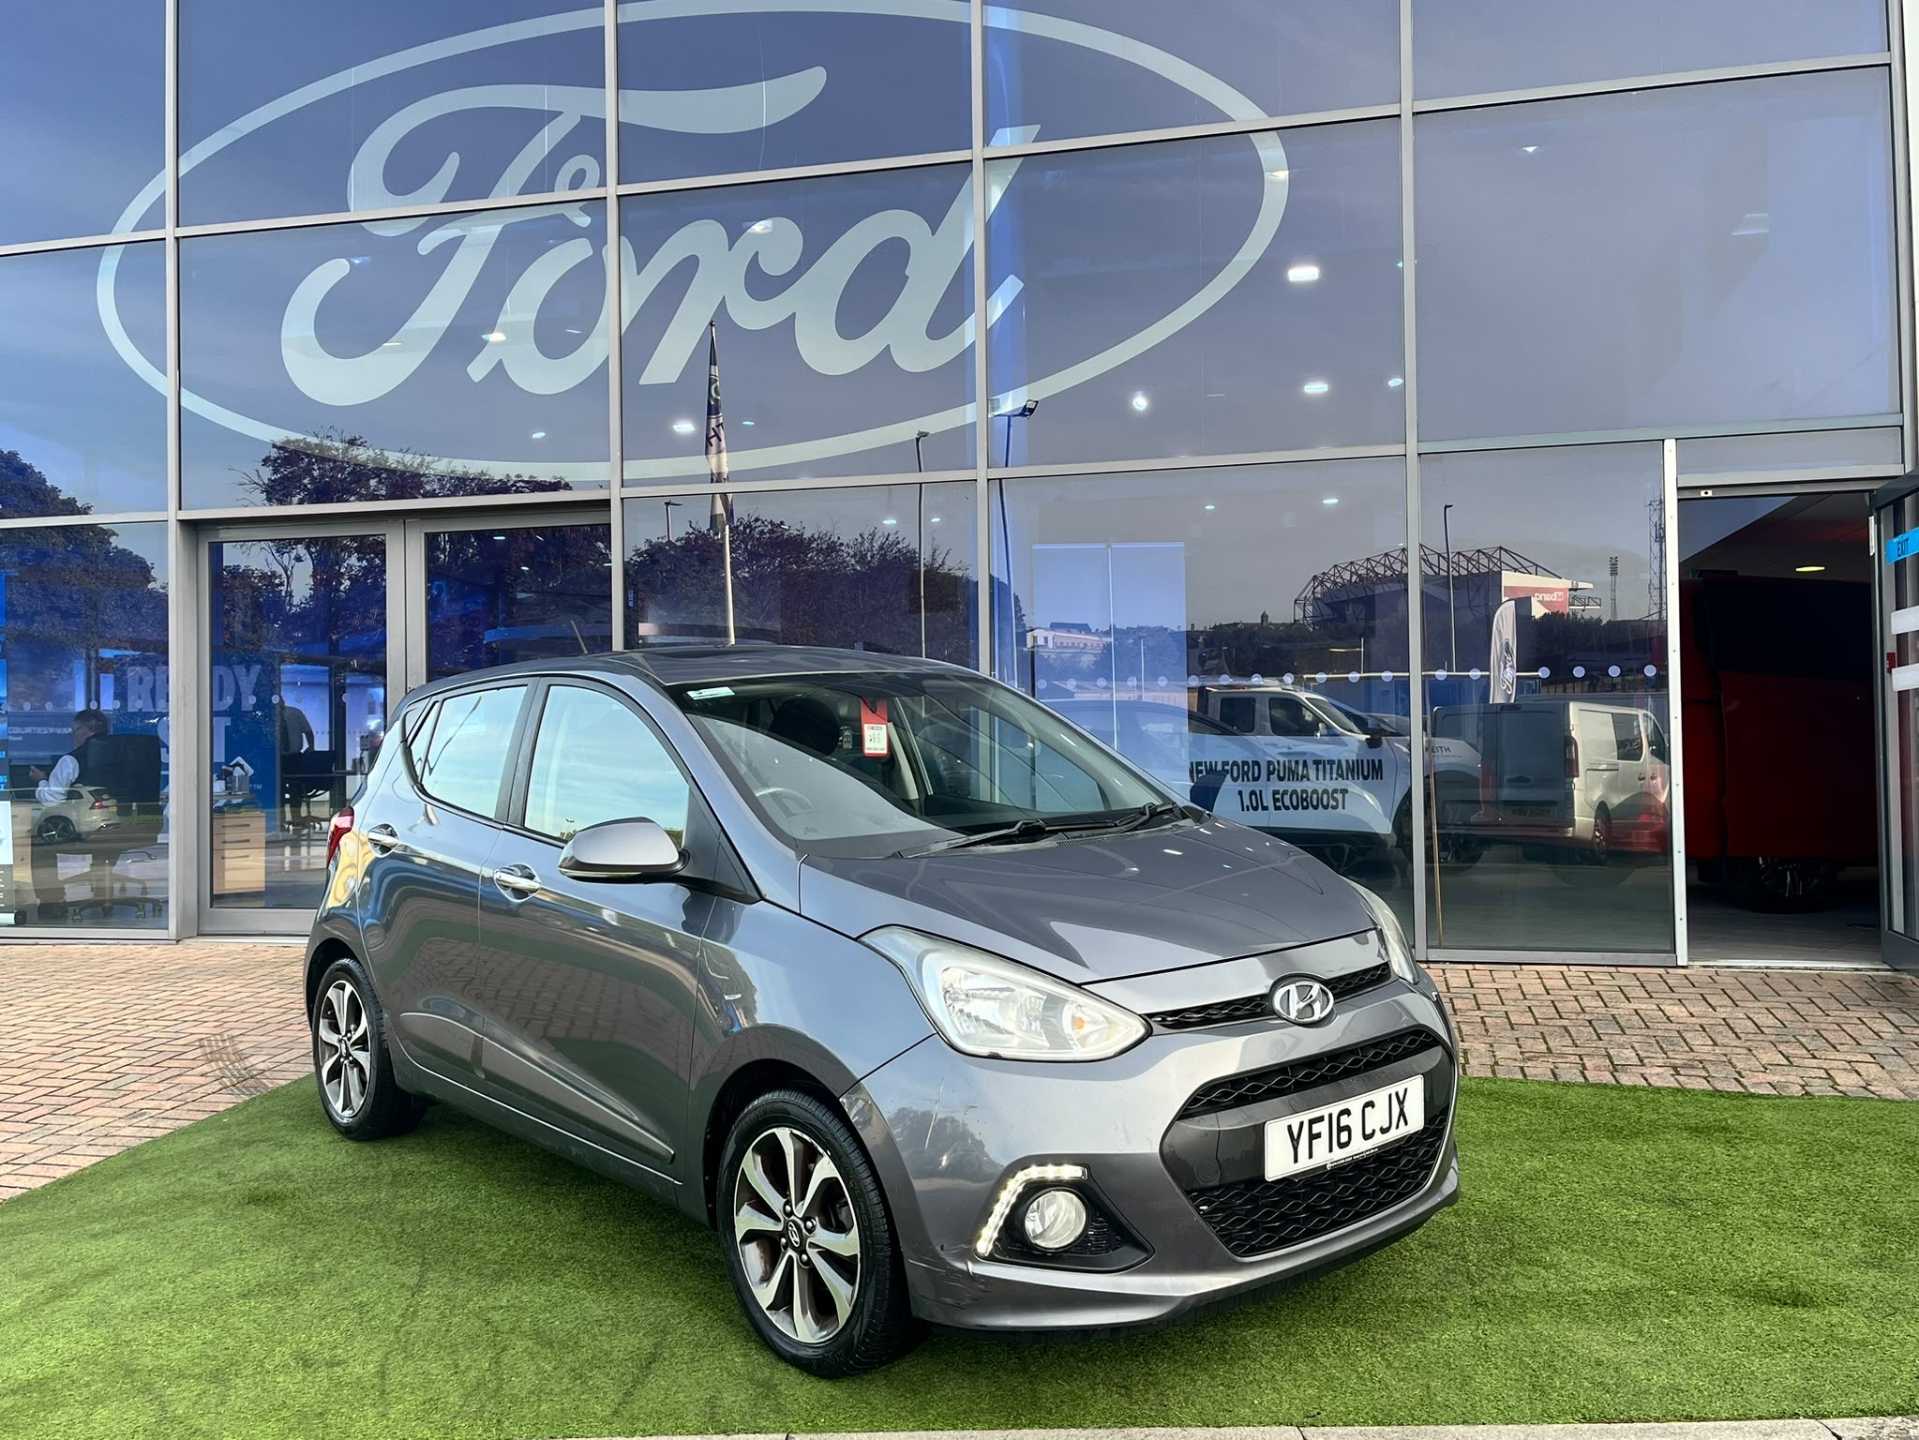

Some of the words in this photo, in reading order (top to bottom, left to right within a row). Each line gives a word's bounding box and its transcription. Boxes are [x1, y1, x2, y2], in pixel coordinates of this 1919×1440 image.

[281, 66, 1041, 406] Ford
[1896, 537, 1910, 557] EXIT
[128, 664, 262, 712] REDY
[1221, 760, 1261, 783] FORD
[1267, 759, 1310, 782] PUMA
[1312, 758, 1384, 781] TITANIUM
[1238, 790, 1269, 813] 1.0L
[1273, 788, 1349, 811] ECOBOOST
[1287, 1107, 1352, 1164] YF16
[1361, 1087, 1409, 1142] CJX
